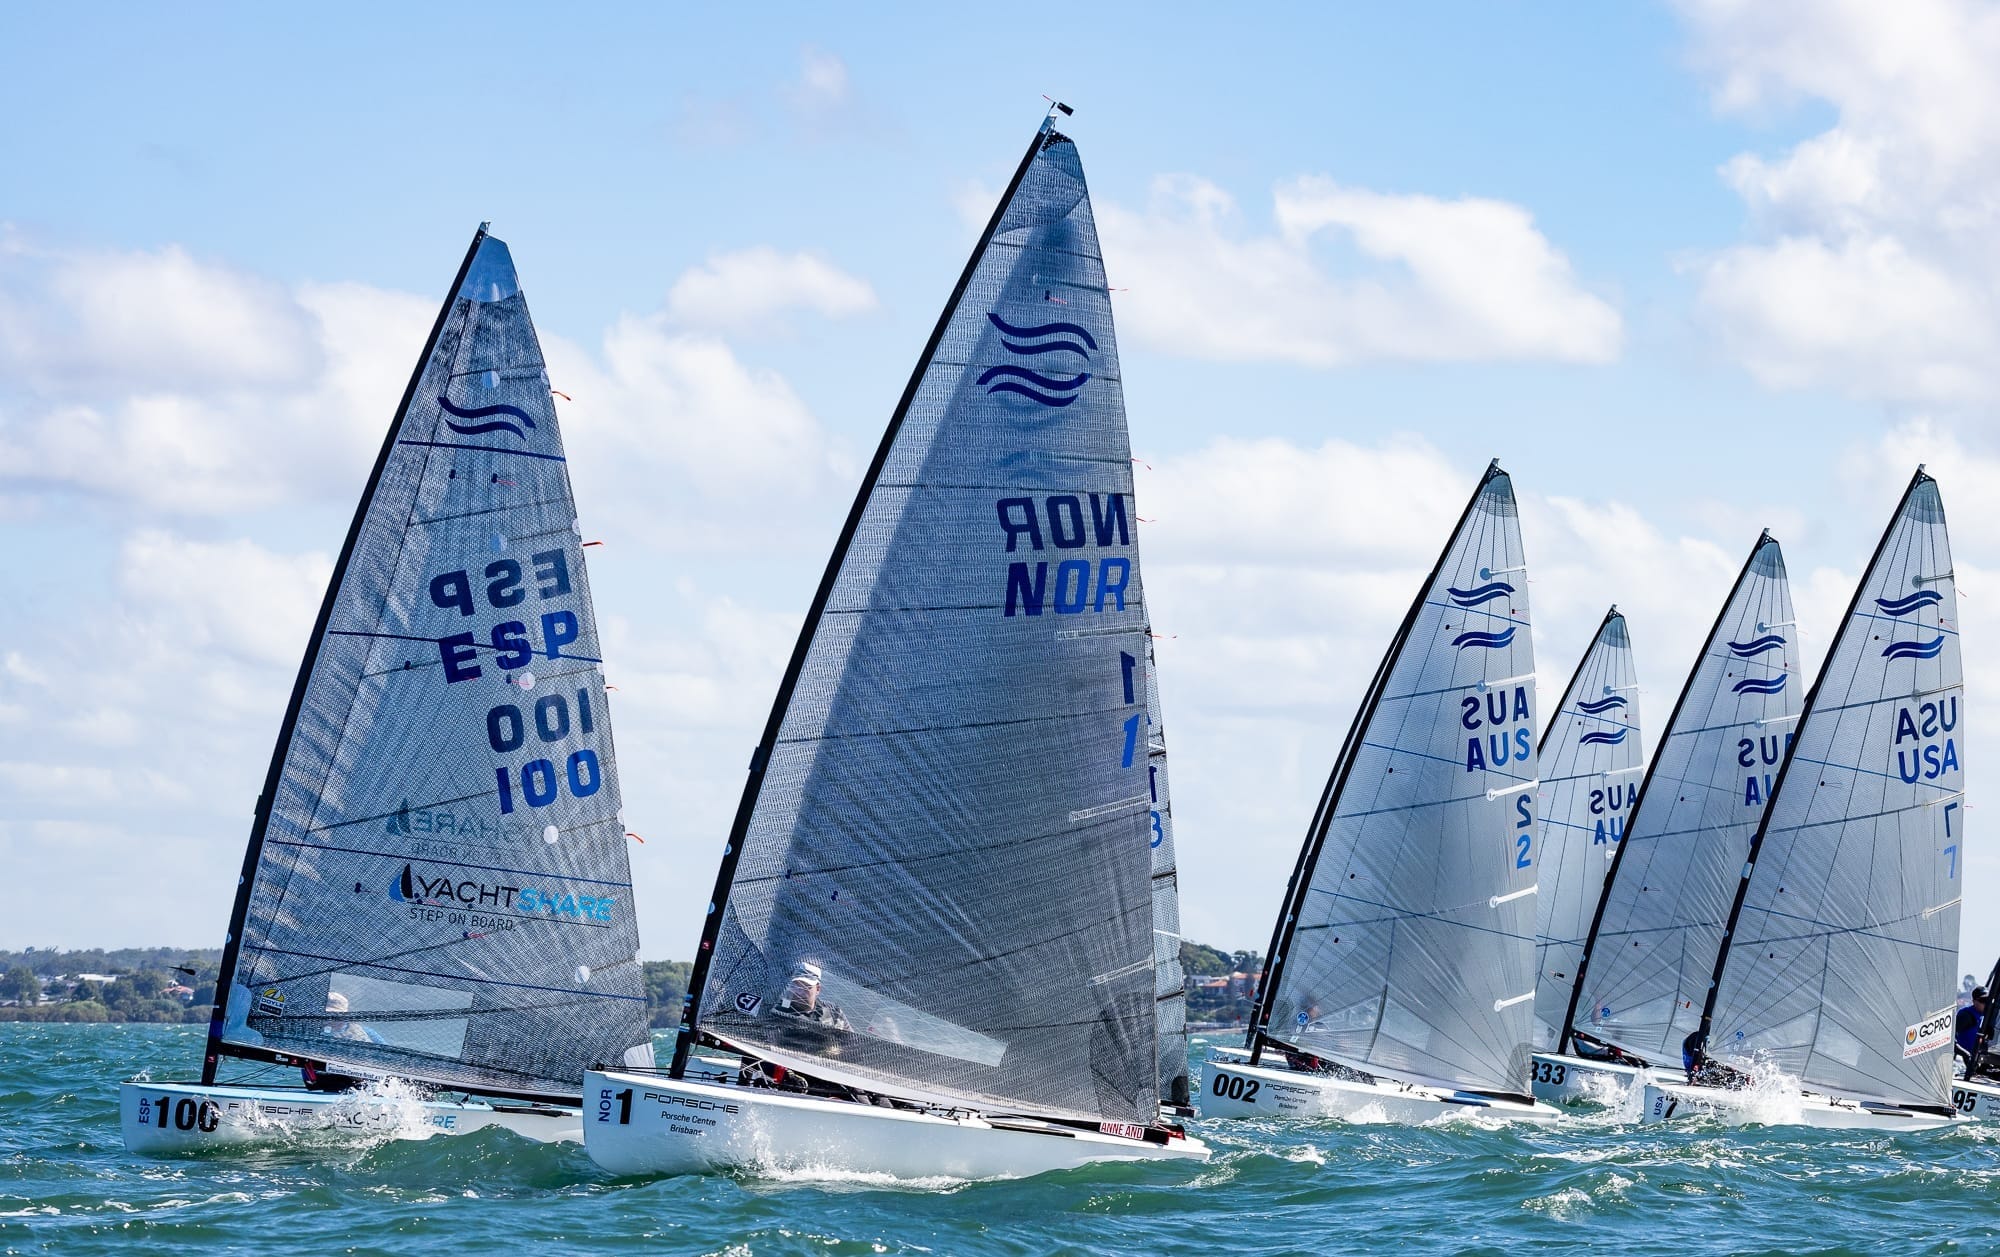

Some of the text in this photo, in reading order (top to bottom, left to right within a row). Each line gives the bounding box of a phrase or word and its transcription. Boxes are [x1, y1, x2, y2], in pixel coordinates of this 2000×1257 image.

[1004, 557, 1131, 617] NOR
[438, 610, 580, 684] ESP
[1121, 714, 1139, 768] 1
[1467, 727, 1531, 772] AUS
[1898, 738, 1959, 784] USA
[496, 748, 601, 815] 100
[1150, 810, 1163, 848] 3
[1594, 816, 1624, 845] AU
[1516, 834, 1531, 870] 2
[1943, 844, 1957, 880] 7
[409, 908, 444, 922] STEP
[448, 913, 466, 927] ON
[1920, 1015, 1952, 1037] GOPRO
[644, 1092, 739, 1114] PORSCHE
[1213, 1073, 1260, 1103] 002
[1653, 1096, 1664, 1115] USA
[1952, 1090, 1977, 1112] 95
[139, 1096, 220, 1132] ESP 100
[598, 1088, 633, 1125] NOR 1
[661, 1110, 717, 1126] Porsche Centre
[1100, 1122, 1143, 1139] ANNE AND
